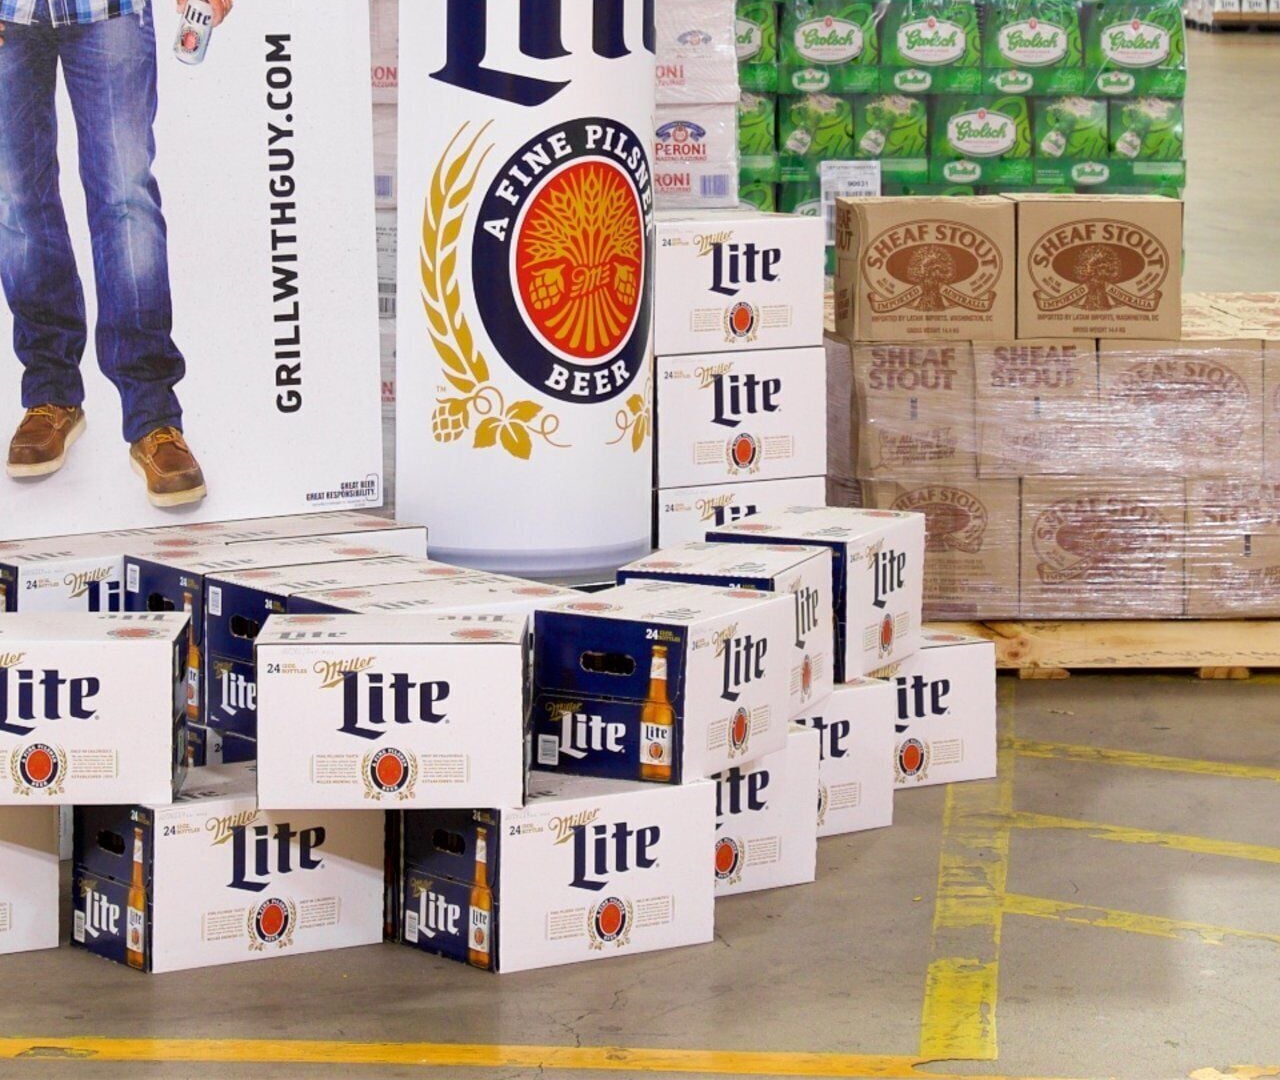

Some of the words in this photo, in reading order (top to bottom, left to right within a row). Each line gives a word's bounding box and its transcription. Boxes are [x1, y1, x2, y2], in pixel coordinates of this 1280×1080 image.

[802, 27, 853, 49] Grolsch
[905, 28, 958, 50] Grolsch
[1007, 29, 1059, 52] Grolsch
[1109, 30, 1162, 53] Grolsch
[956, 120, 1008, 141] Grolsch
[495, 132, 573, 206] FINE
[265, 34, 302, 414] GRILLWITHGUY.COM
[483, 217, 509, 242] A
[662, 238, 672, 247] 24
[693, 231, 734, 258] Miller
[867, 223, 928, 270] SHEAF
[935, 223, 998, 270] STOUT
[1033, 223, 1096, 269] SHEAF
[1102, 223, 1164, 270] STOUT
[708, 242, 781, 296] Lite
[870, 347, 956, 369] SHEAF
[544, 364, 631, 397] BEER
[664, 370, 673, 380] 24
[695, 362, 734, 390] Miller
[868, 369, 957, 391] STOUT
[710, 373, 781, 428] Lite
[695, 493, 736, 522] Miller
[26, 580, 38, 589] 24
[63, 566, 115, 599] Miller
[872, 549, 906, 609] Lite
[646, 629, 658, 640] 24
[794, 586, 819, 650] Lite
[267, 663, 281, 674] 24
[313, 656, 377, 689] Miller
[720, 635, 767, 702] Lite
[220, 668, 257, 716] Lite
[337, 671, 450, 740] Lite
[559, 711, 626, 759] Lite
[645, 724, 667, 741] Lite
[163, 826, 176, 836] 24
[205, 809, 261, 846] Miller
[509, 825, 520, 836] 24
[548, 808, 600, 846] Miller
[226, 823, 325, 893] Lite
[569, 822, 660, 891] Lite
[84, 887, 120, 938] Lite
[418, 887, 460, 939] Lite
